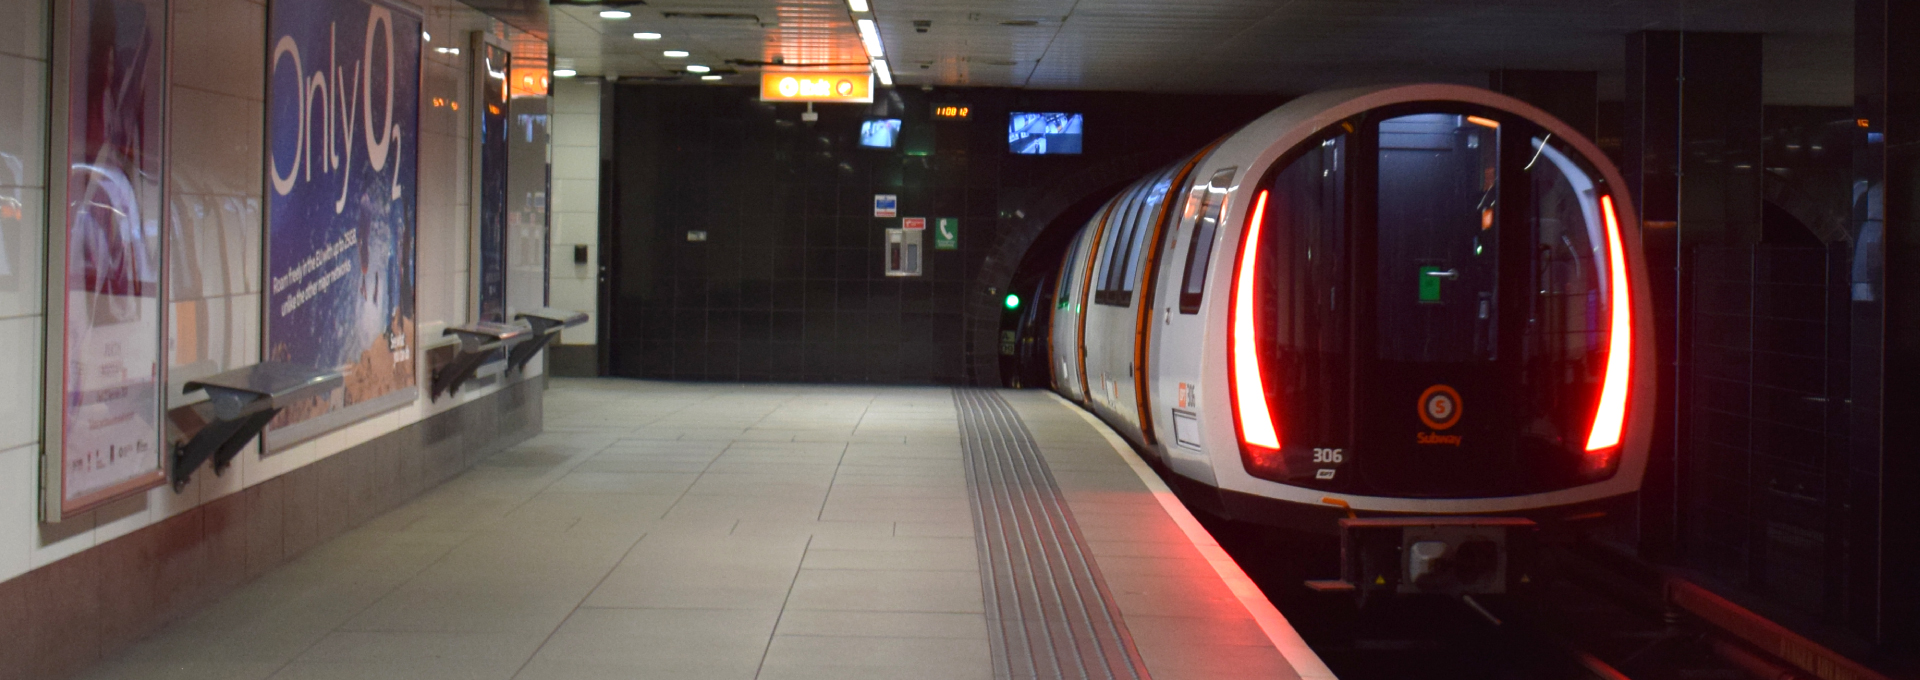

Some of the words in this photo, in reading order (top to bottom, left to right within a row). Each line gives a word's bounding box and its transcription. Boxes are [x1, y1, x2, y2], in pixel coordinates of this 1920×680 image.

[271, 20, 360, 214] Only
[1435, 400, 1446, 414] S
[1417, 431, 1462, 446] Subway
[1313, 447, 1343, 463] 306
